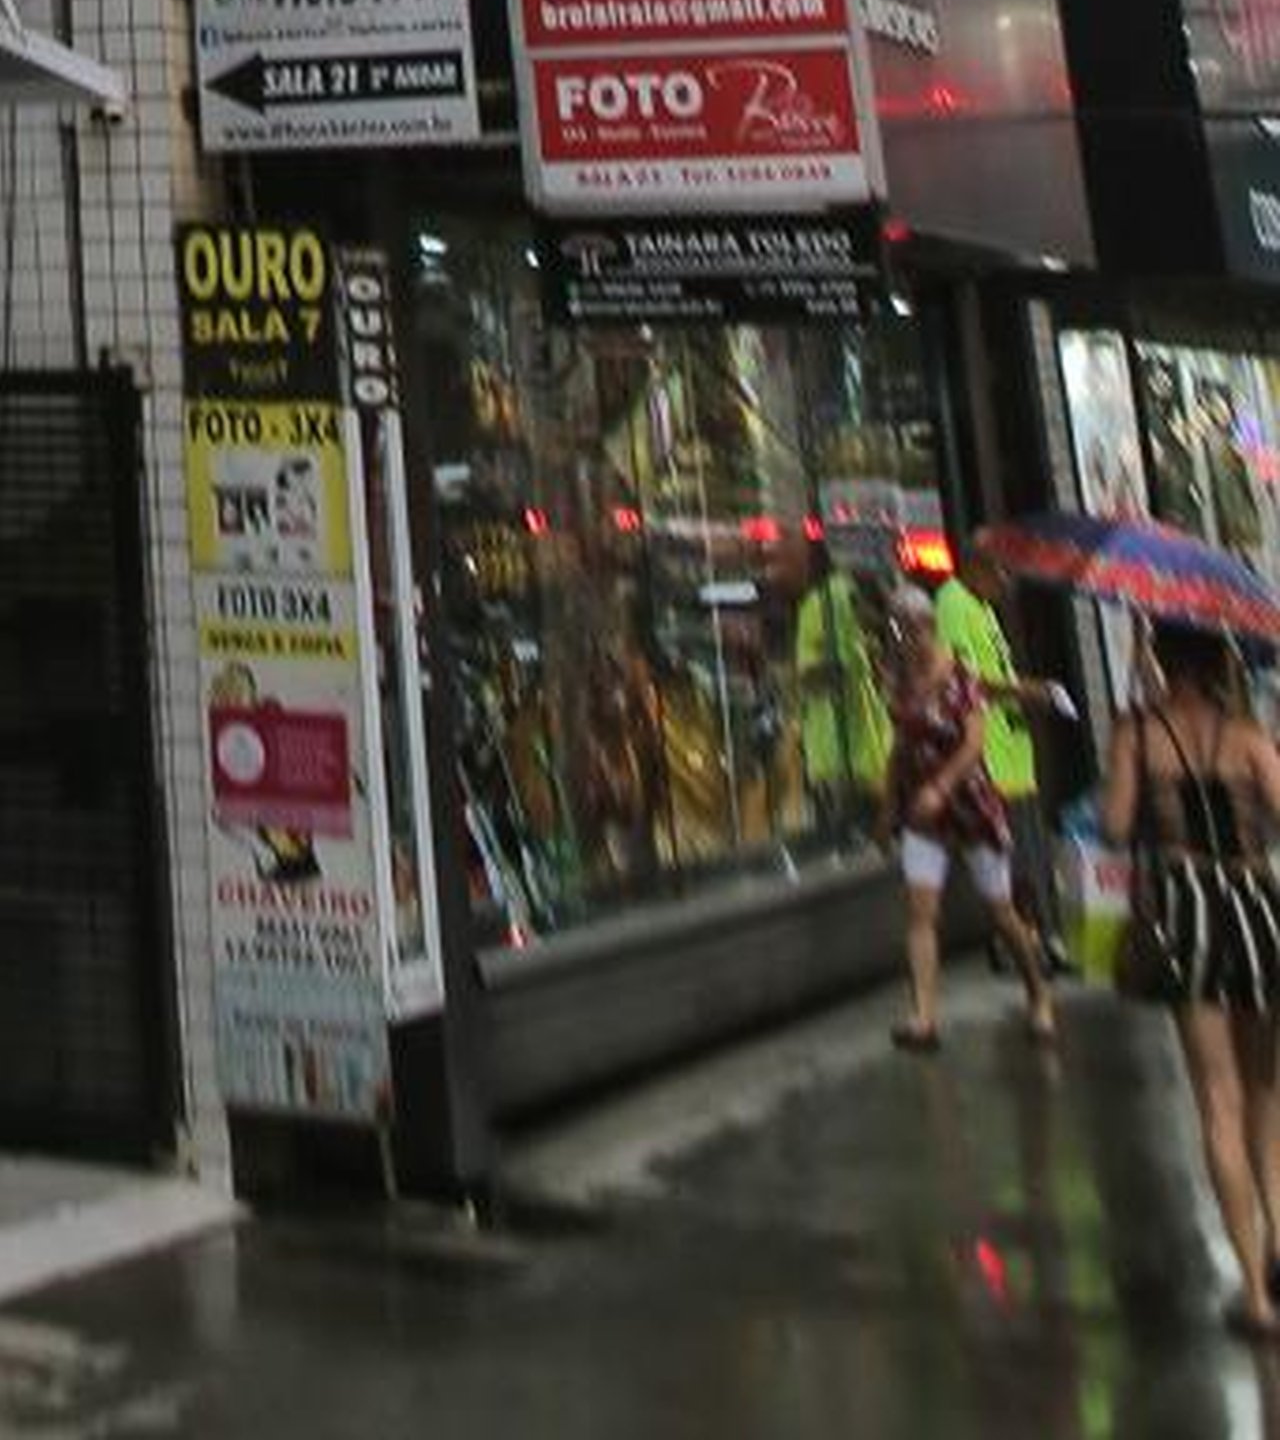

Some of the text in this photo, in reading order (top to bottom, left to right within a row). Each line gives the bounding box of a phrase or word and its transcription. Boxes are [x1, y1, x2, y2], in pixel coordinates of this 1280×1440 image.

[261, 63, 325, 98] SALA
[556, 70, 704, 122] FOTO
[183, 229, 327, 302] OURO
[190, 306, 322, 347] SALA 7
[188, 402, 264, 446] FOTO
[216, 582, 279, 623] FOTO
